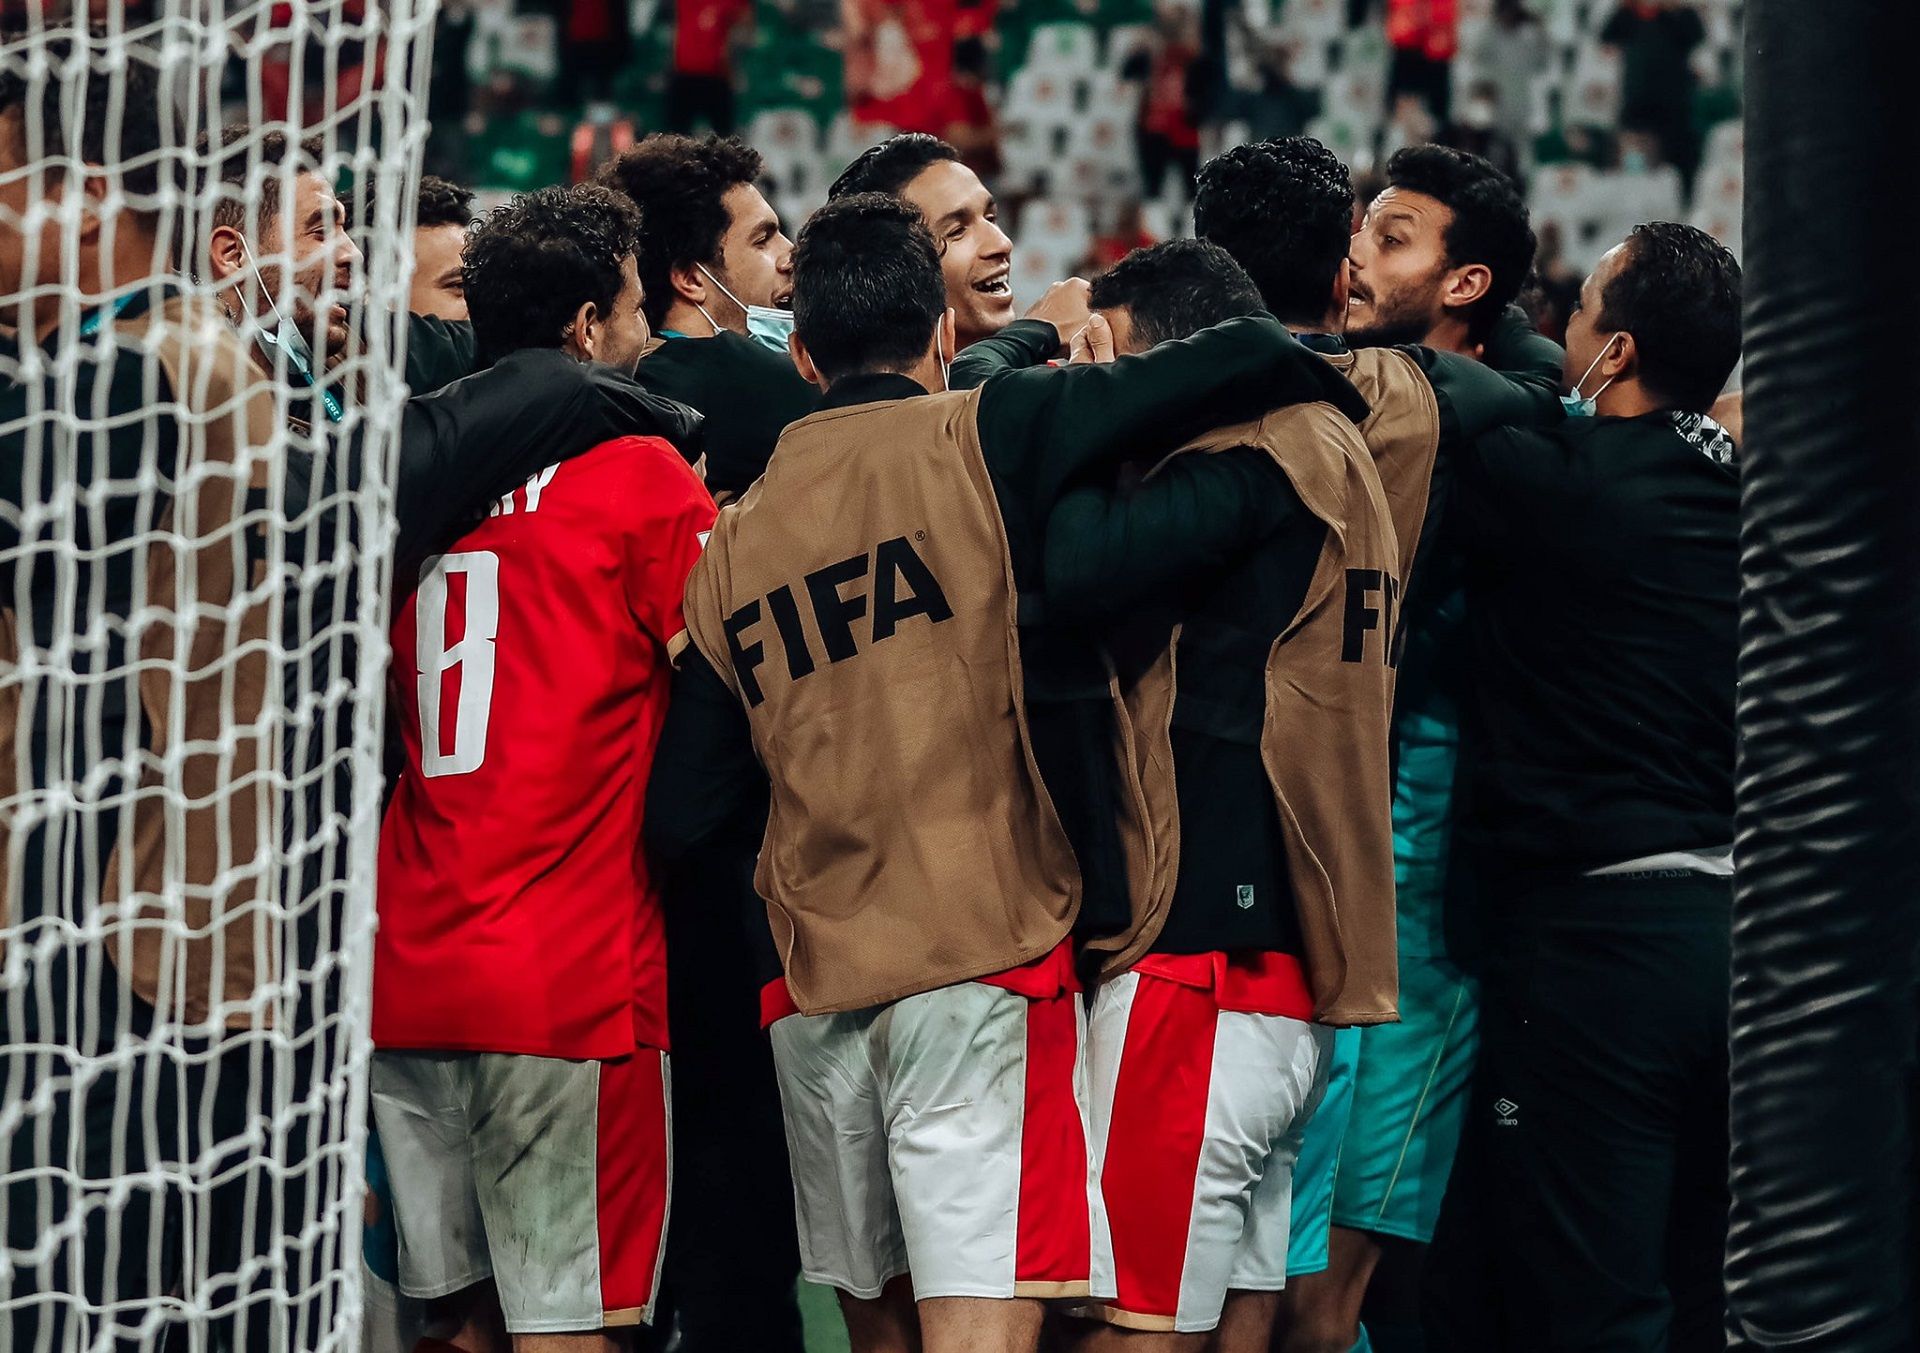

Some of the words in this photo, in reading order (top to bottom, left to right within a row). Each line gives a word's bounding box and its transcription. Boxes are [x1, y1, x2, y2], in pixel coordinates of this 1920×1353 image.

[416, 550, 499, 778] 8
[723, 535, 955, 709] FIFA
[1341, 568, 1399, 669] FI
